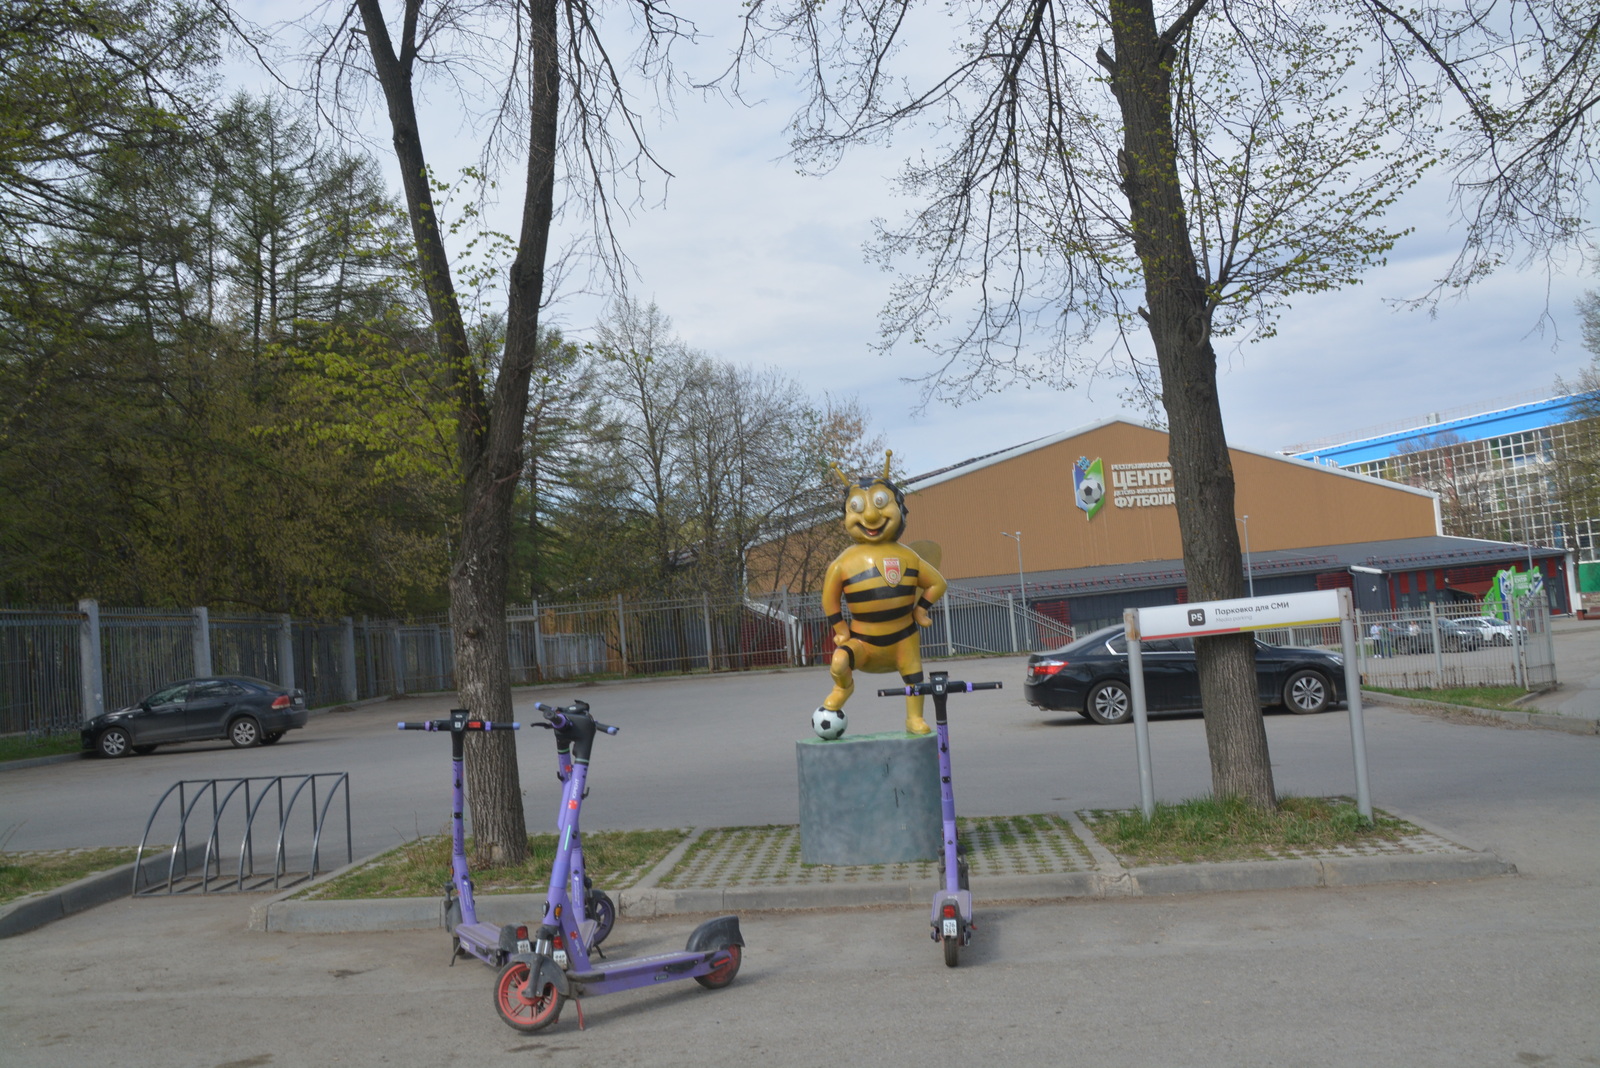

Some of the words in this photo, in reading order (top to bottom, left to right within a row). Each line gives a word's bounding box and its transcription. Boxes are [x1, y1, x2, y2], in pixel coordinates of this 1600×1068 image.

[1112, 469, 1172, 490] ЦЕНТР
[1114, 493, 1176, 508] ФУТБОЛА
[1215, 607, 1254, 616] Парковка
[1255, 604, 1269, 612] для
[1191, 613, 1203, 622] P5
